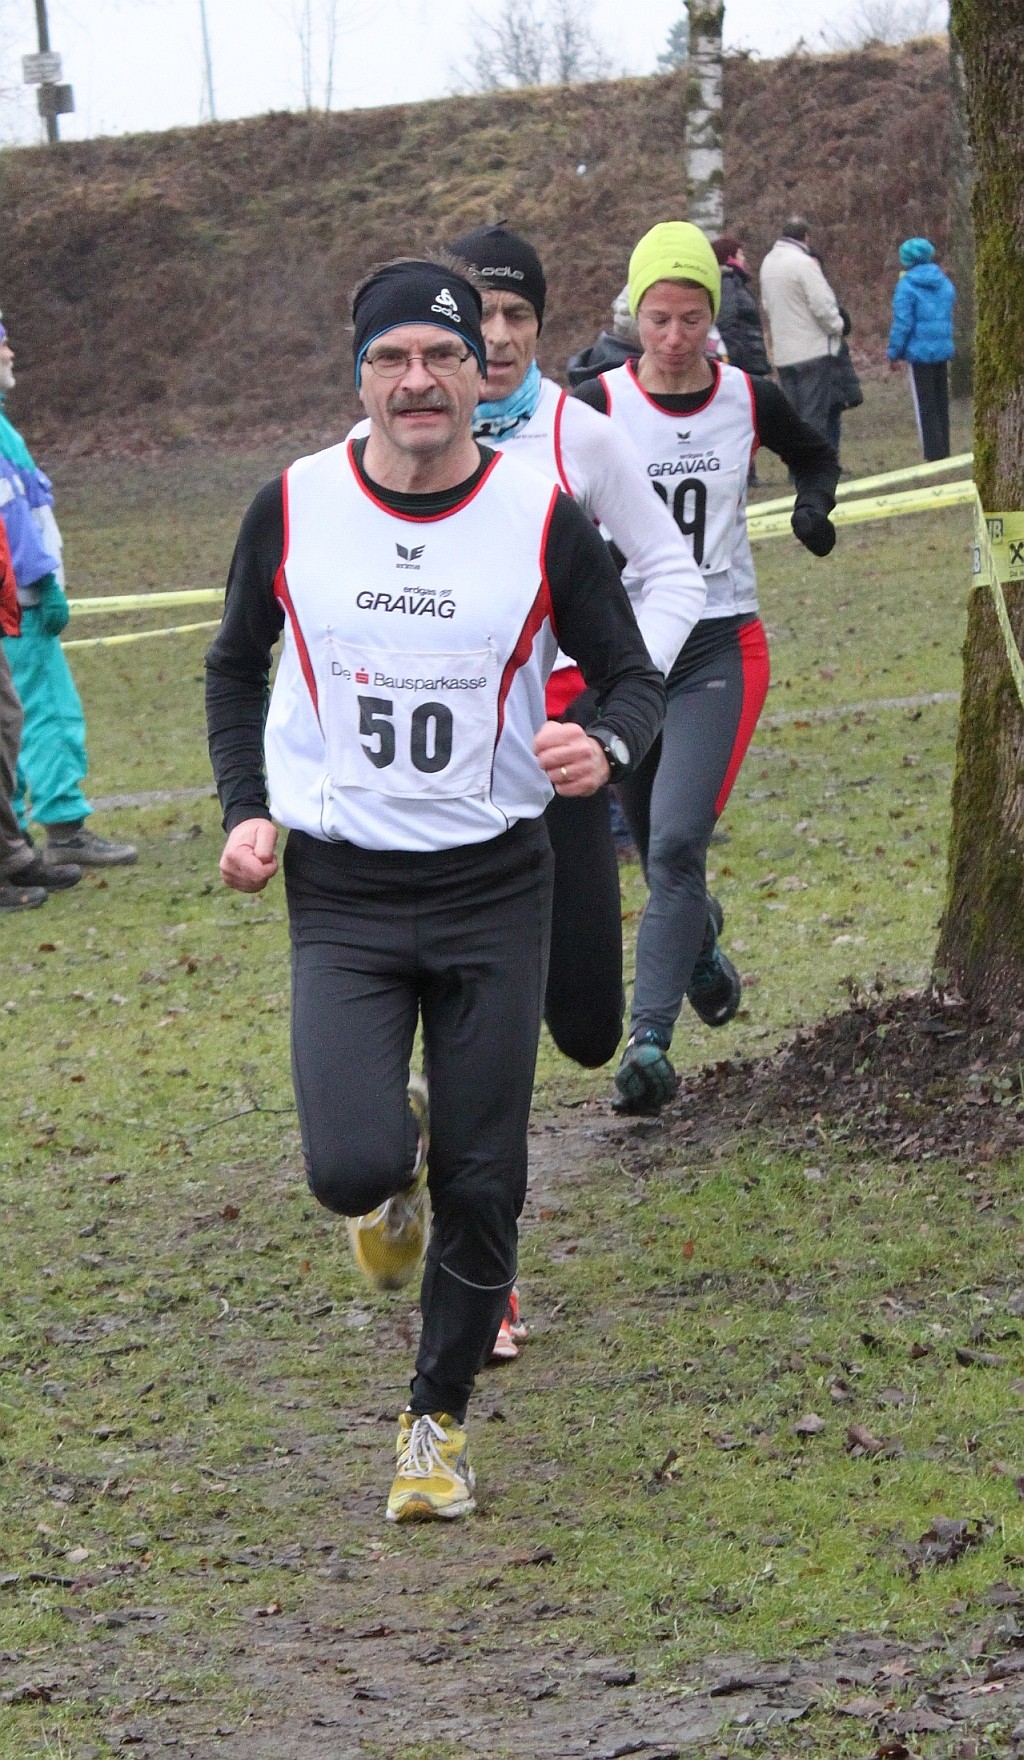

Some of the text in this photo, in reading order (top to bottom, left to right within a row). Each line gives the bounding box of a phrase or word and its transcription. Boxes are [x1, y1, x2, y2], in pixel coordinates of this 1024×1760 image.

[431, 304, 461, 322] odlo
[647, 457, 720, 477] GRAVAG
[652, 477, 707, 567] 9
[403, 586, 436, 596] erdgas
[356, 591, 456, 619] GRAVAG
[374, 672, 487, 692] Bausparkasse
[357, 695, 453, 774] 50
